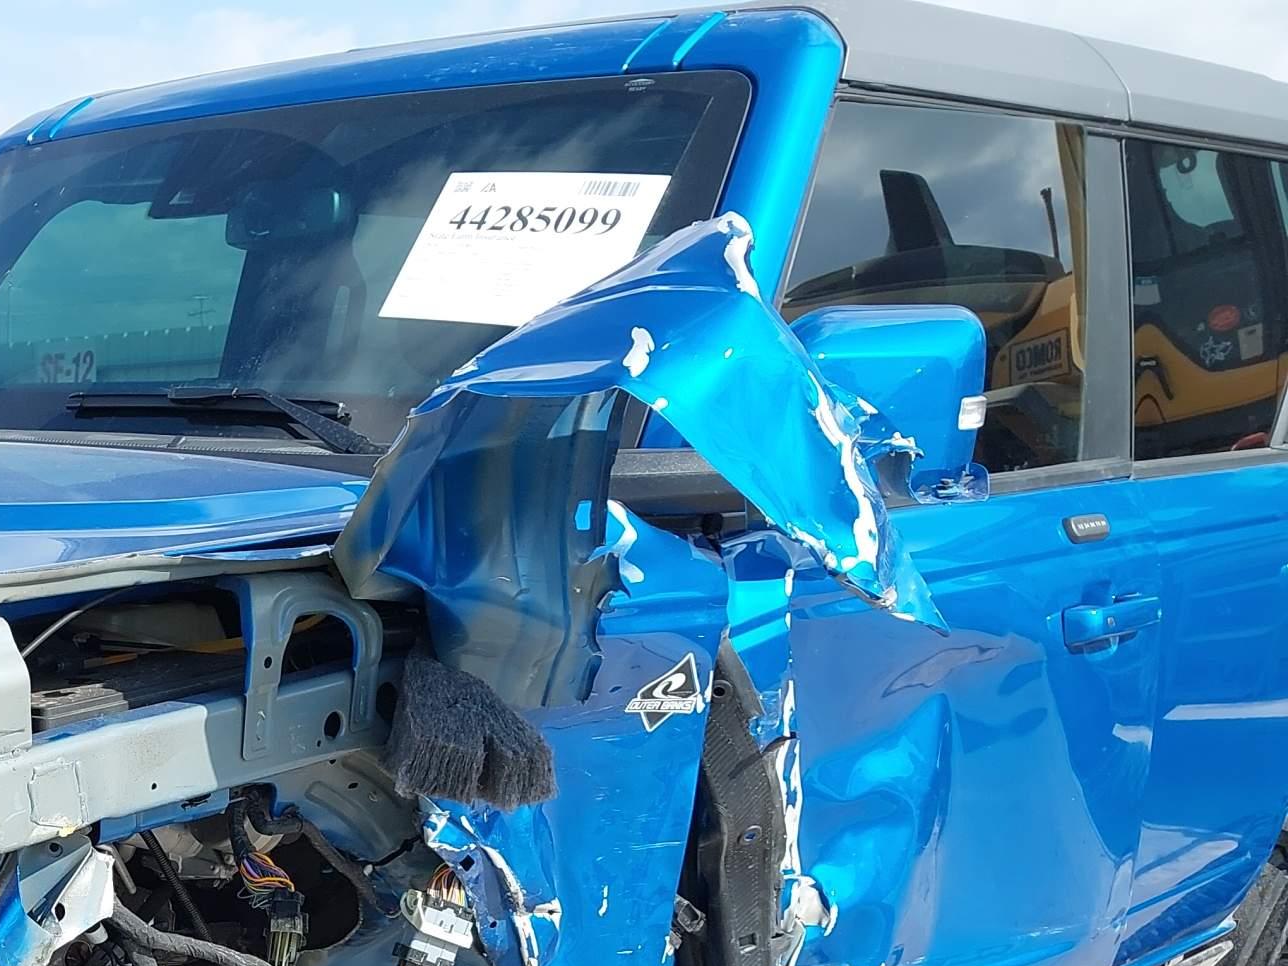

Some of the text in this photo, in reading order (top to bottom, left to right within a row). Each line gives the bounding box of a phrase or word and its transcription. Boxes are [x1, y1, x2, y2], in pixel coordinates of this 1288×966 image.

[448, 204, 622, 236] 44285099
[40, 350, 94, 384] SF-12
[628, 700, 692, 711] OUTER BANKS
